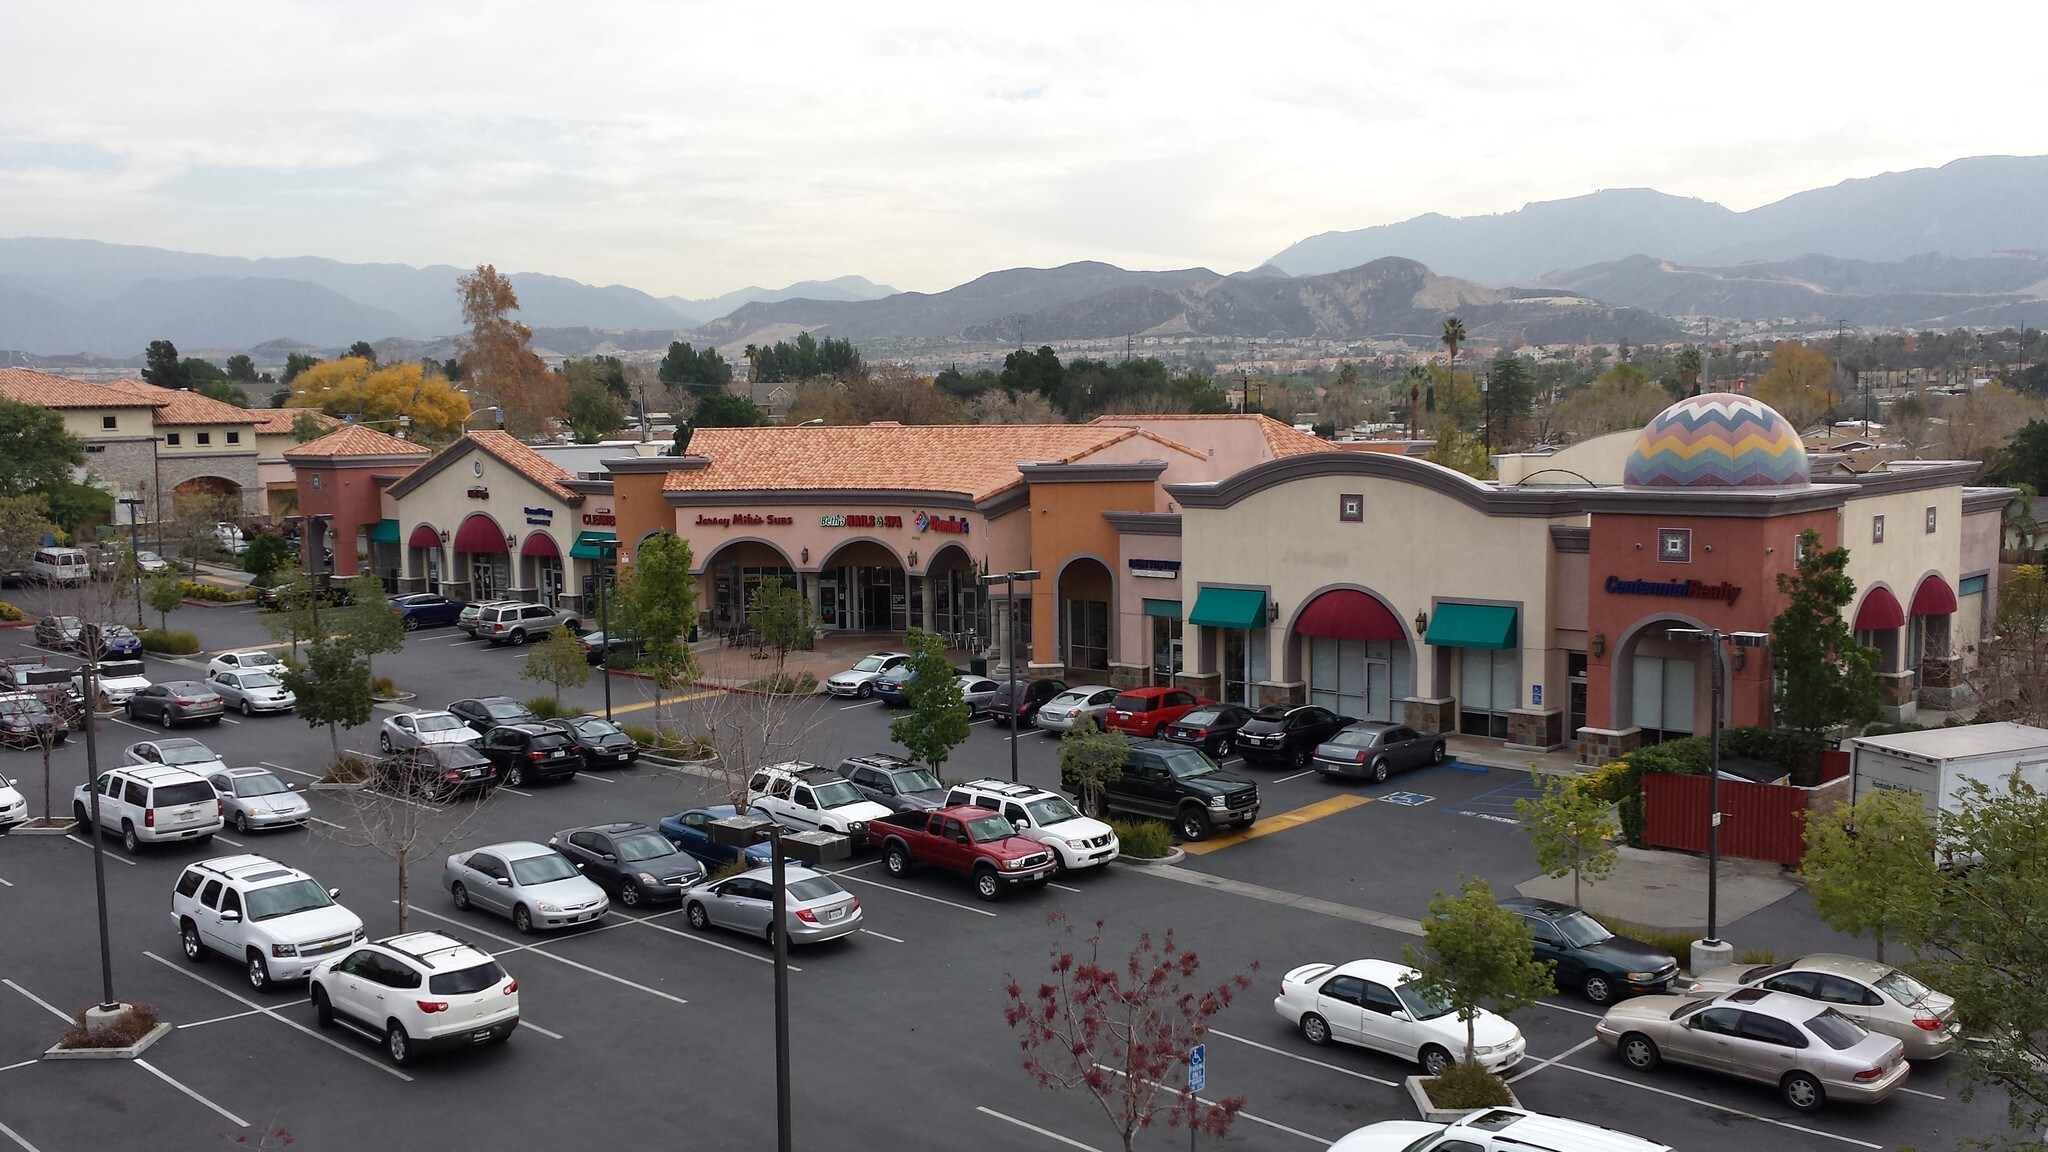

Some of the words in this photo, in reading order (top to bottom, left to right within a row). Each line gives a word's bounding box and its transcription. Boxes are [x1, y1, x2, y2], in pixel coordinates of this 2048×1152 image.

[695, 514, 730, 528] Jersey
[732, 513, 765, 526] Mike's
[766, 514, 794, 526] Subs
[820, 514, 847, 528] Beth's
[846, 514, 876, 528] NAILS
[875, 515, 884, 528] &
[884, 515, 903, 528] SPA
[930, 515, 970, 535] Domino's
[1475, 813, 1522, 825] PARKING
